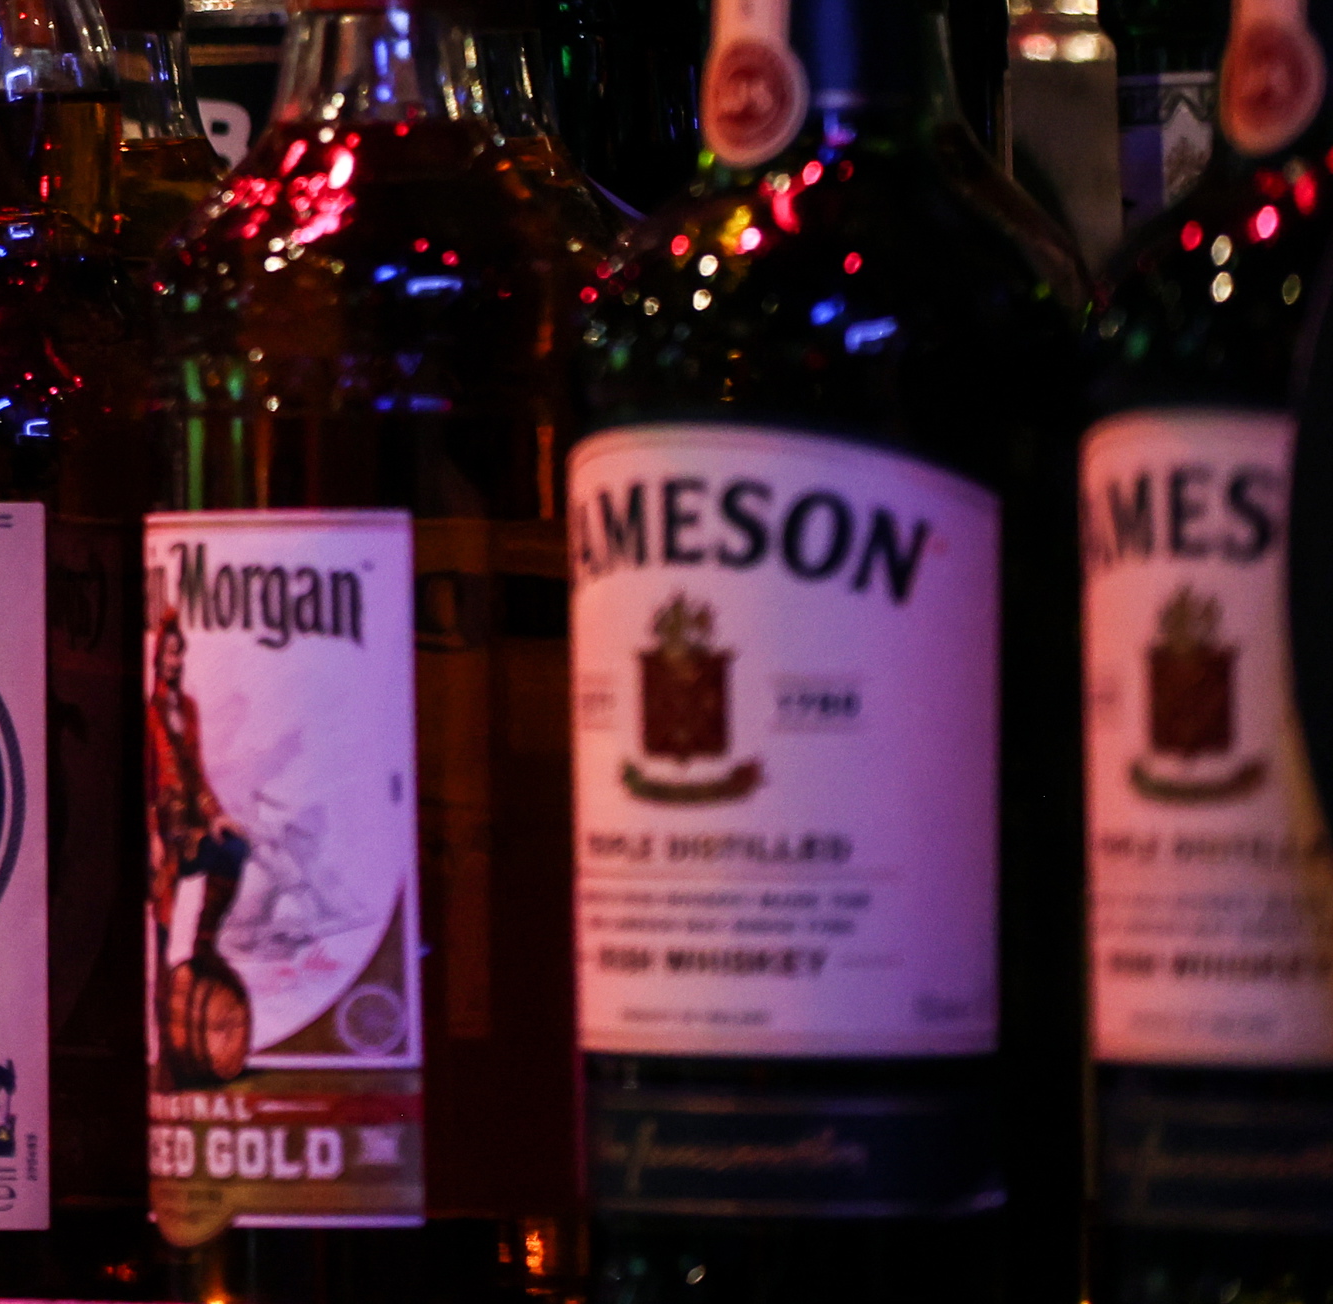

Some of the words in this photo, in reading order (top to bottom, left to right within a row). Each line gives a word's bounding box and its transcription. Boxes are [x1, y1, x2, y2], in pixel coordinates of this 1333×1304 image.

[573, 472, 931, 606] AMESON
[169, 542, 364, 652] Morgan
[149, 1127, 196, 1178] ED
[205, 1126, 346, 1180] GOLD
